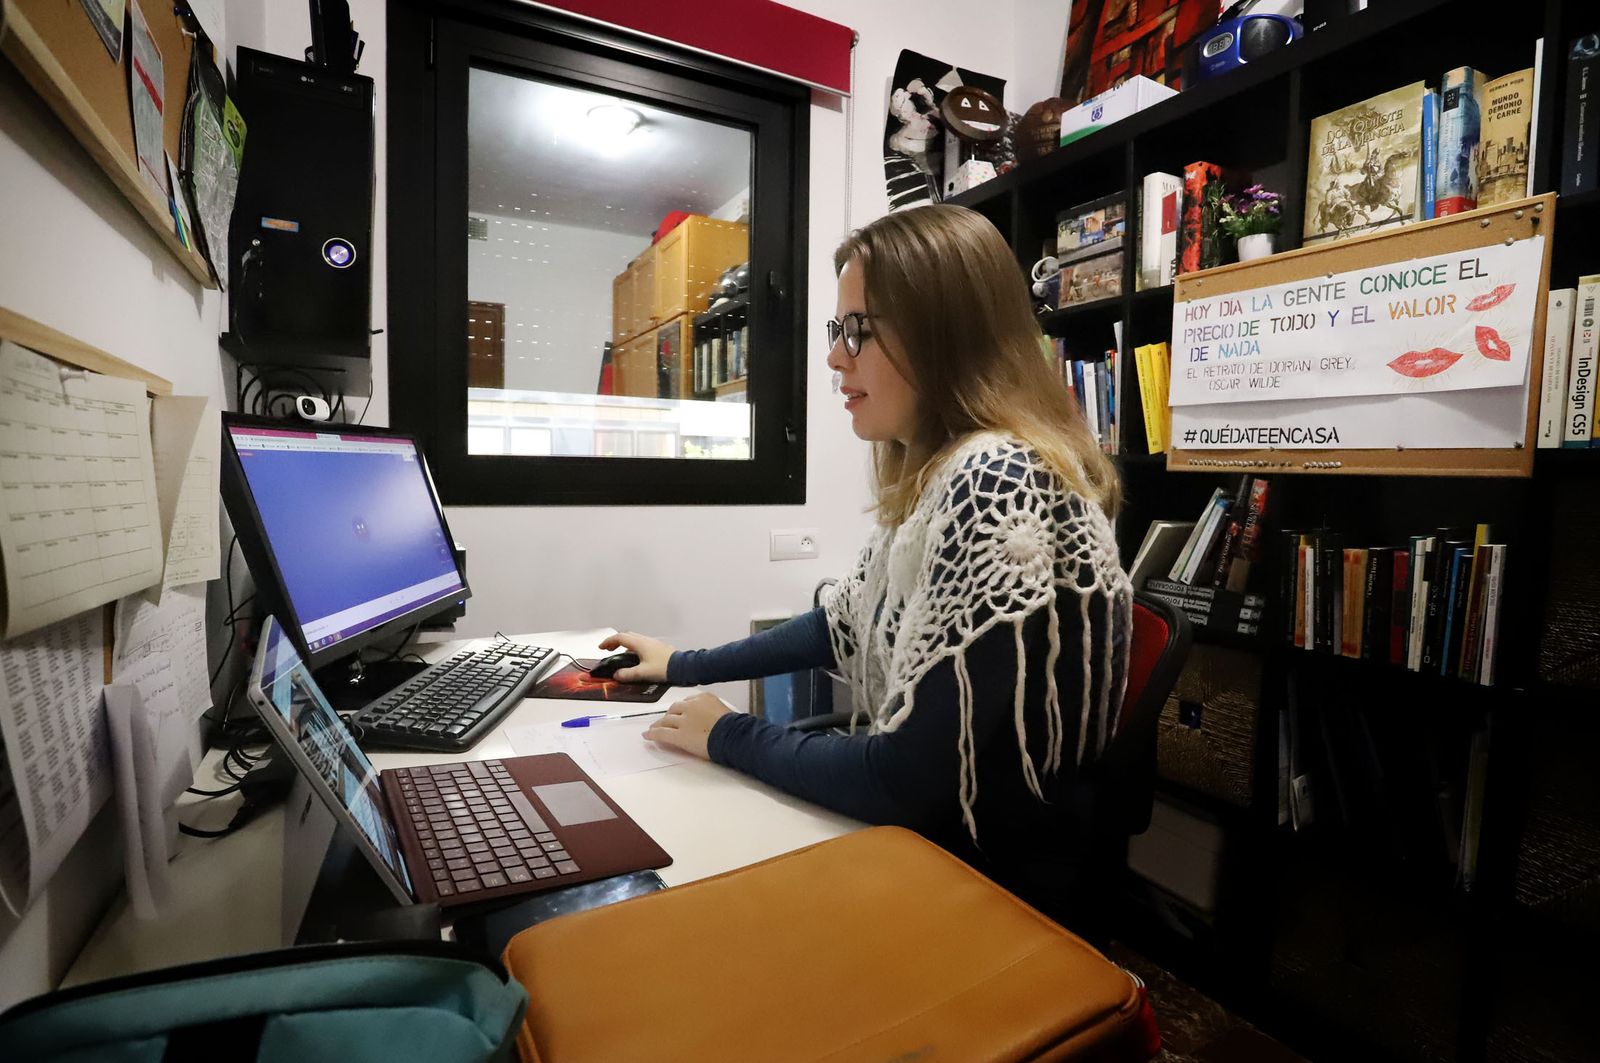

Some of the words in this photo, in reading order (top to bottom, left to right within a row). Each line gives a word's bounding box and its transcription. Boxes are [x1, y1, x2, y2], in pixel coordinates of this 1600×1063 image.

[1488, 99, 1523, 115] DEMONIO
[1492, 92, 1519, 106] MUNDO
[1496, 107, 1521, 120] CARNE
[1321, 143, 1336, 156] DE
[1337, 140, 1352, 151] LA
[1355, 121, 1406, 148] MANCHA
[1325, 119, 1354, 145] DON
[1353, 109, 1404, 133] QUIJOTE
[1185, 303, 1211, 322] HOY
[1252, 294, 1273, 313] LA
[1283, 281, 1347, 307] GENTE
[1360, 264, 1448, 295] CONOCE
[1458, 258, 1488, 281] EL
[1184, 323, 1234, 344] PRECIO
[1238, 319, 1261, 338] DE
[1270, 313, 1316, 334] TODO
[1327, 310, 1340, 328] Y
[1351, 305, 1376, 325] EL
[1388, 294, 1457, 321] VALOR
[1190, 346, 1210, 363] DE
[1217, 340, 1261, 360] NADA
[1186, 367, 1198, 380] EL
[1203, 363, 1245, 378] RETRATO
[1249, 362, 1264, 375] DE
[1269, 359, 1312, 373] DORIAN
[1209, 378, 1241, 391] OSCAR
[1249, 376, 1281, 389] WILDE
[1571, 357, 1592, 410] InDesign
[1183, 424, 1340, 445] #QUÉDATEENCASA
[1572, 413, 1587, 436] CS5
